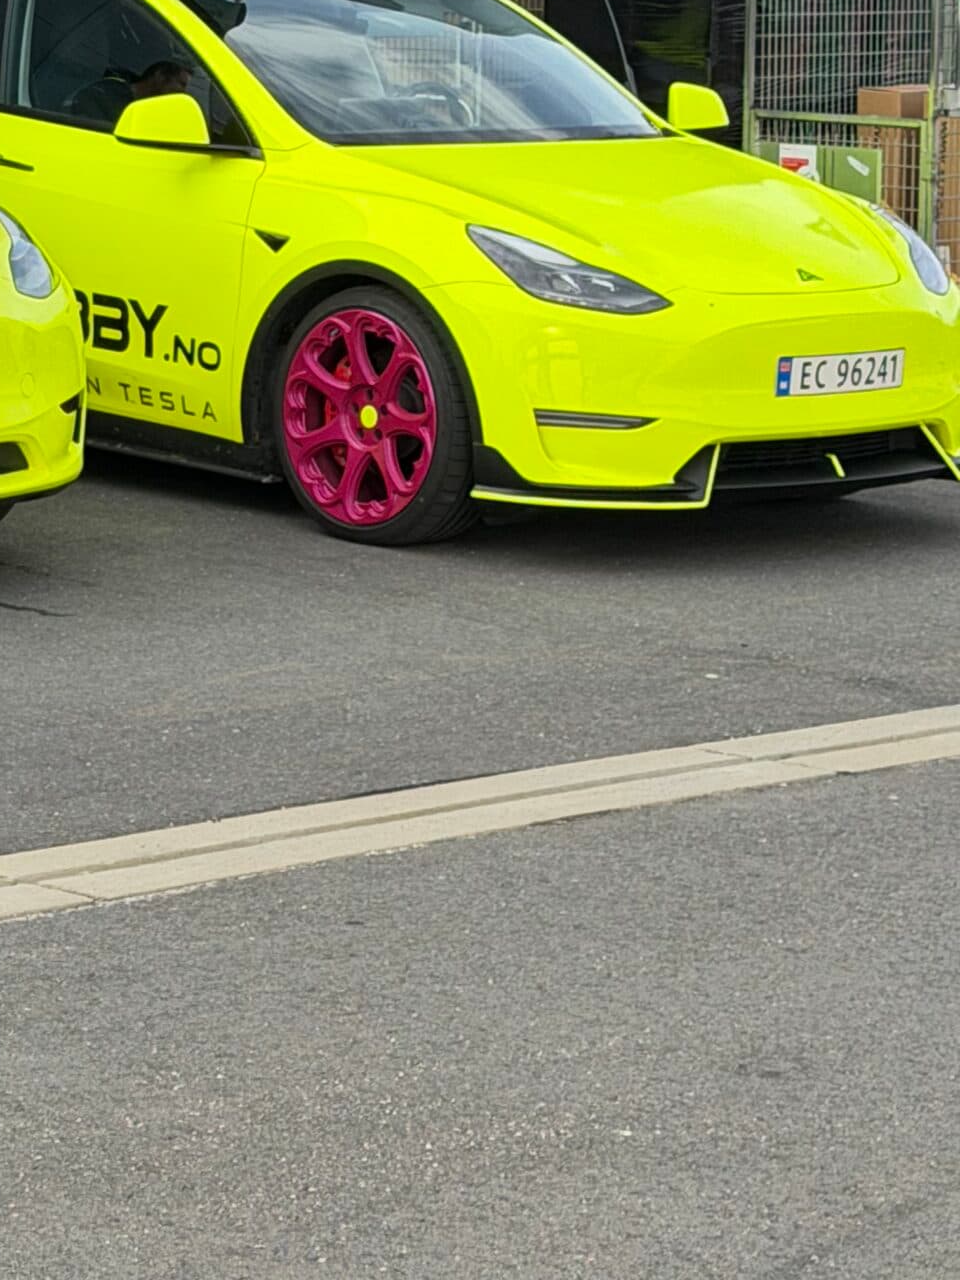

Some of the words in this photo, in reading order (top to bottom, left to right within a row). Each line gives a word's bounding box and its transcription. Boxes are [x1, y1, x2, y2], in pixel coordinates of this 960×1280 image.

[800, 359, 828, 390] EC
[837, 354, 898, 388] 96241
[118, 381, 218, 423] TESLA
